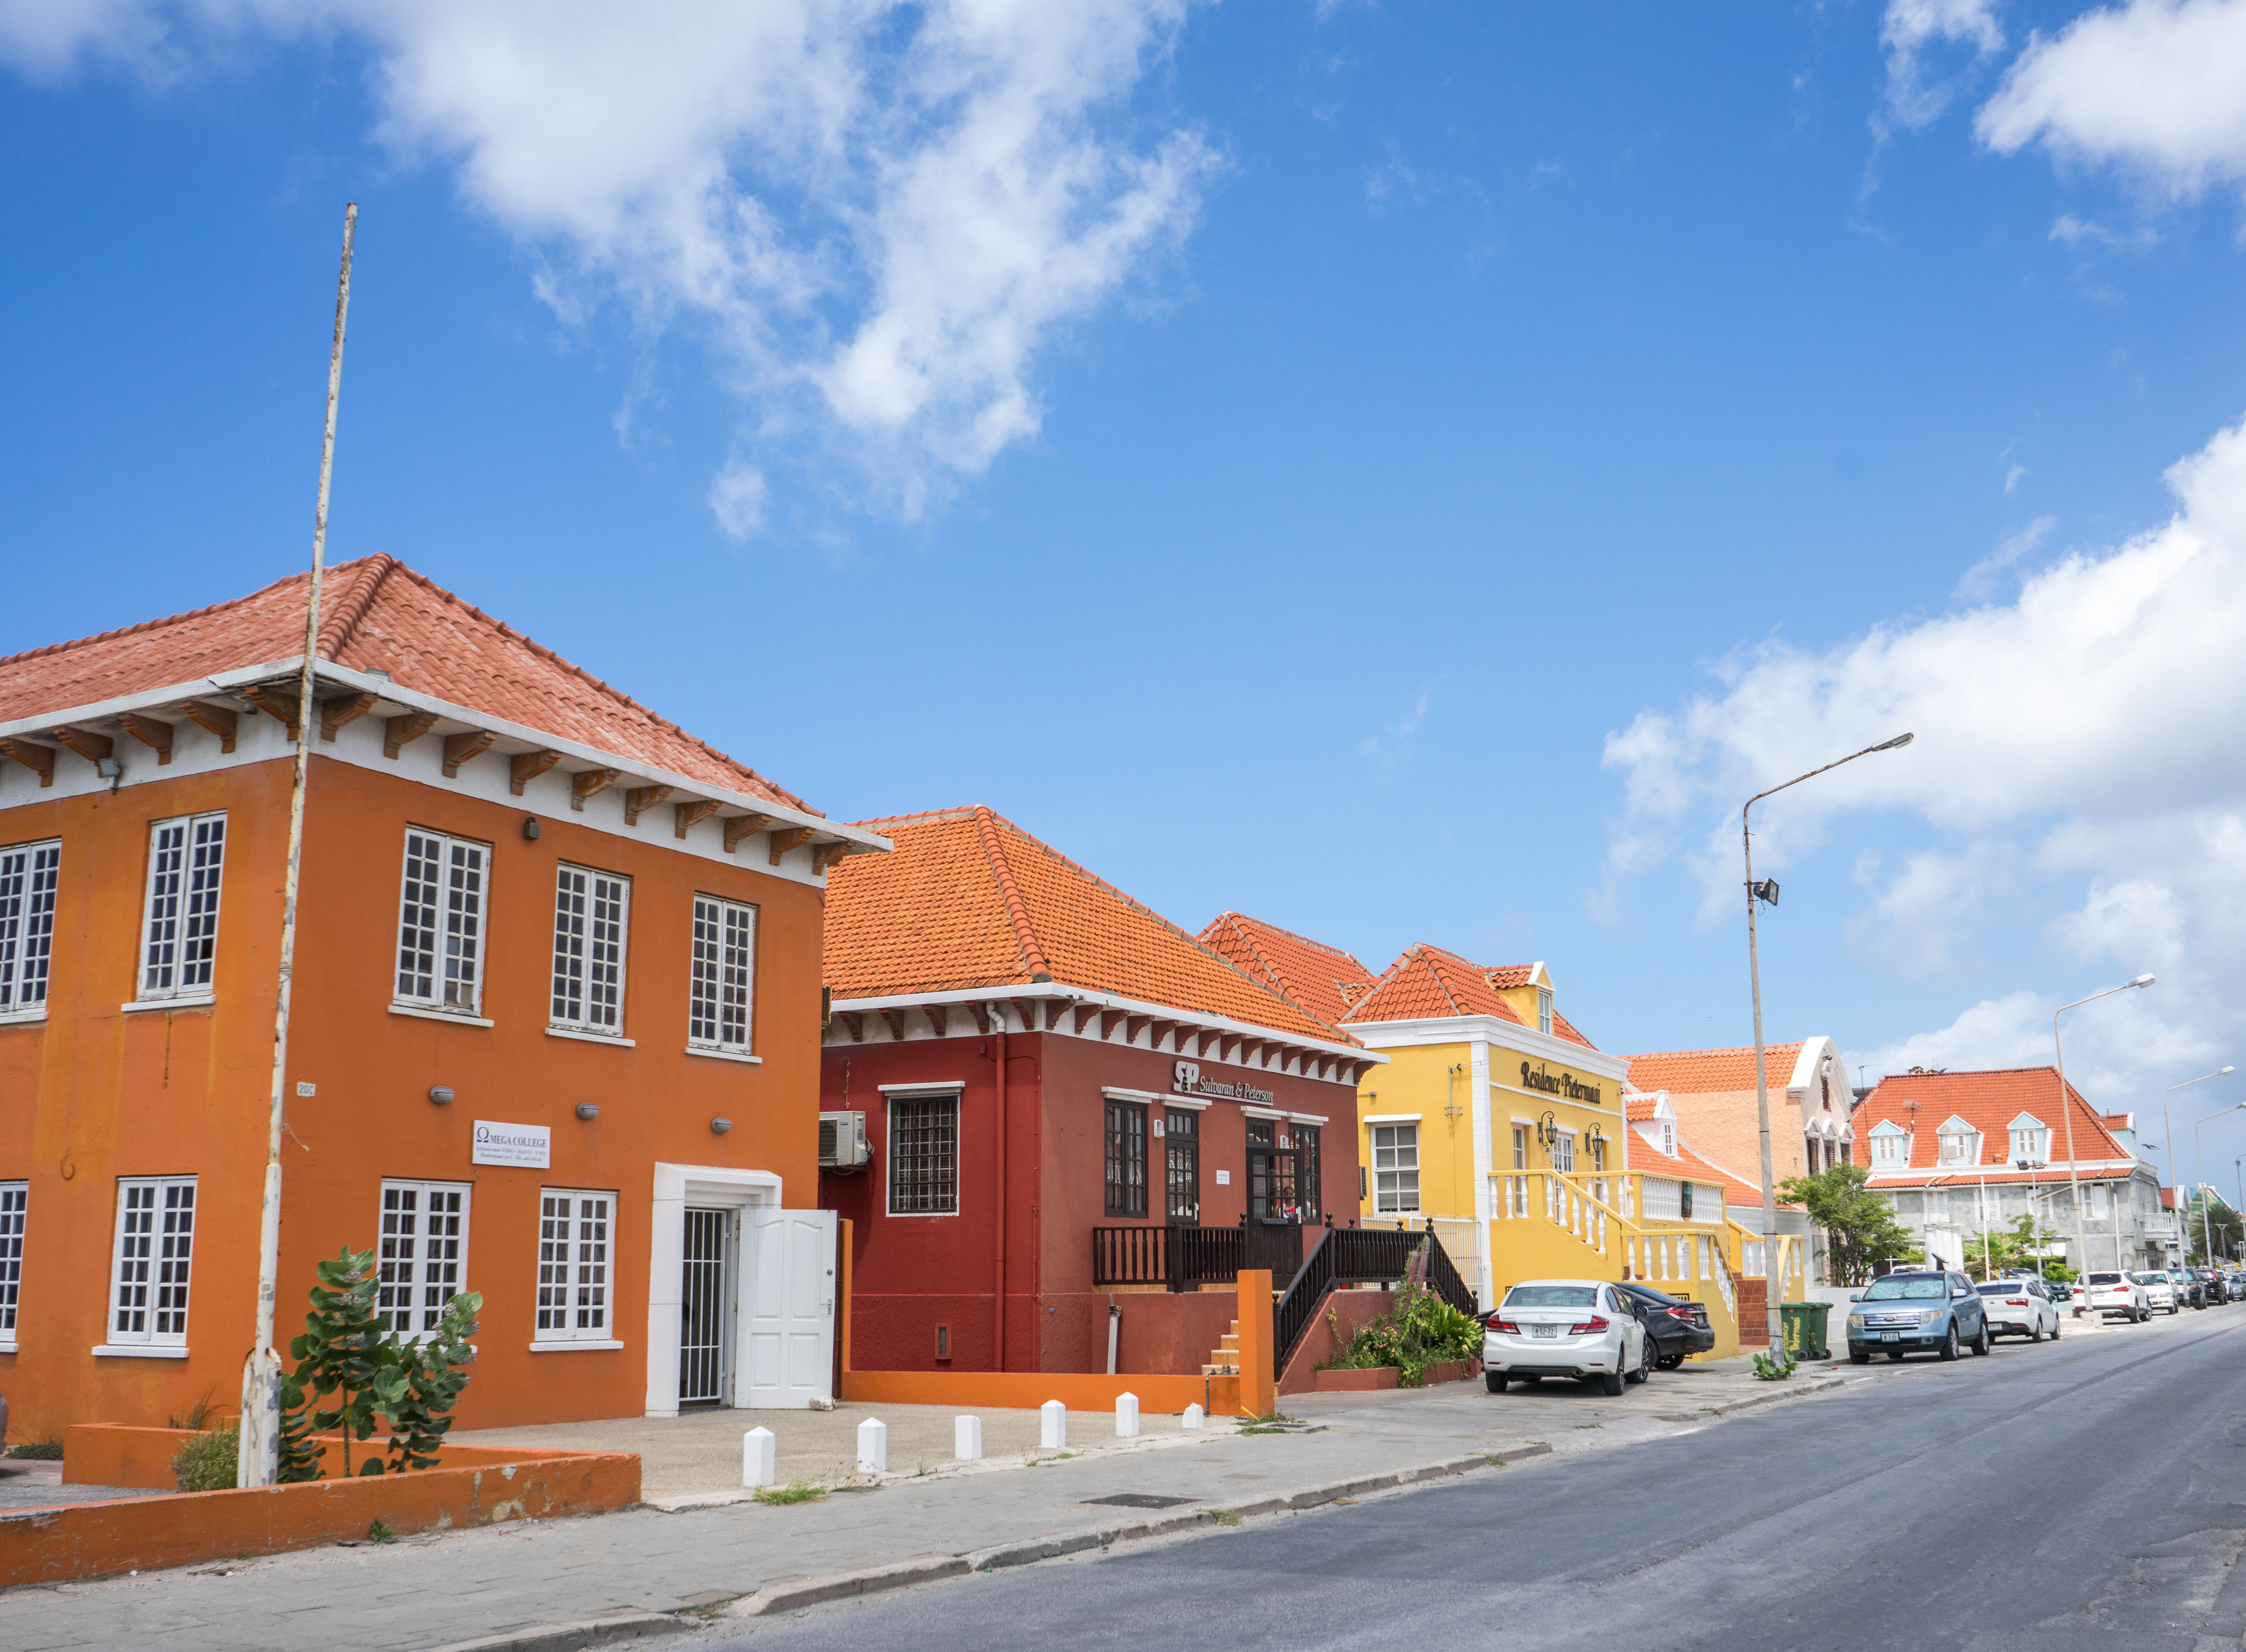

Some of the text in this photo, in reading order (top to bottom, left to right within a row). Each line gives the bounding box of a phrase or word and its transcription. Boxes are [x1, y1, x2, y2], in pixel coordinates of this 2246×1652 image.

[1200, 1076, 1273, 1102] Sulvaran & Peterson
[1521, 1061, 1600, 1104] Residence Pietermaai
[513, 1137, 547, 1147] COLLEGE
